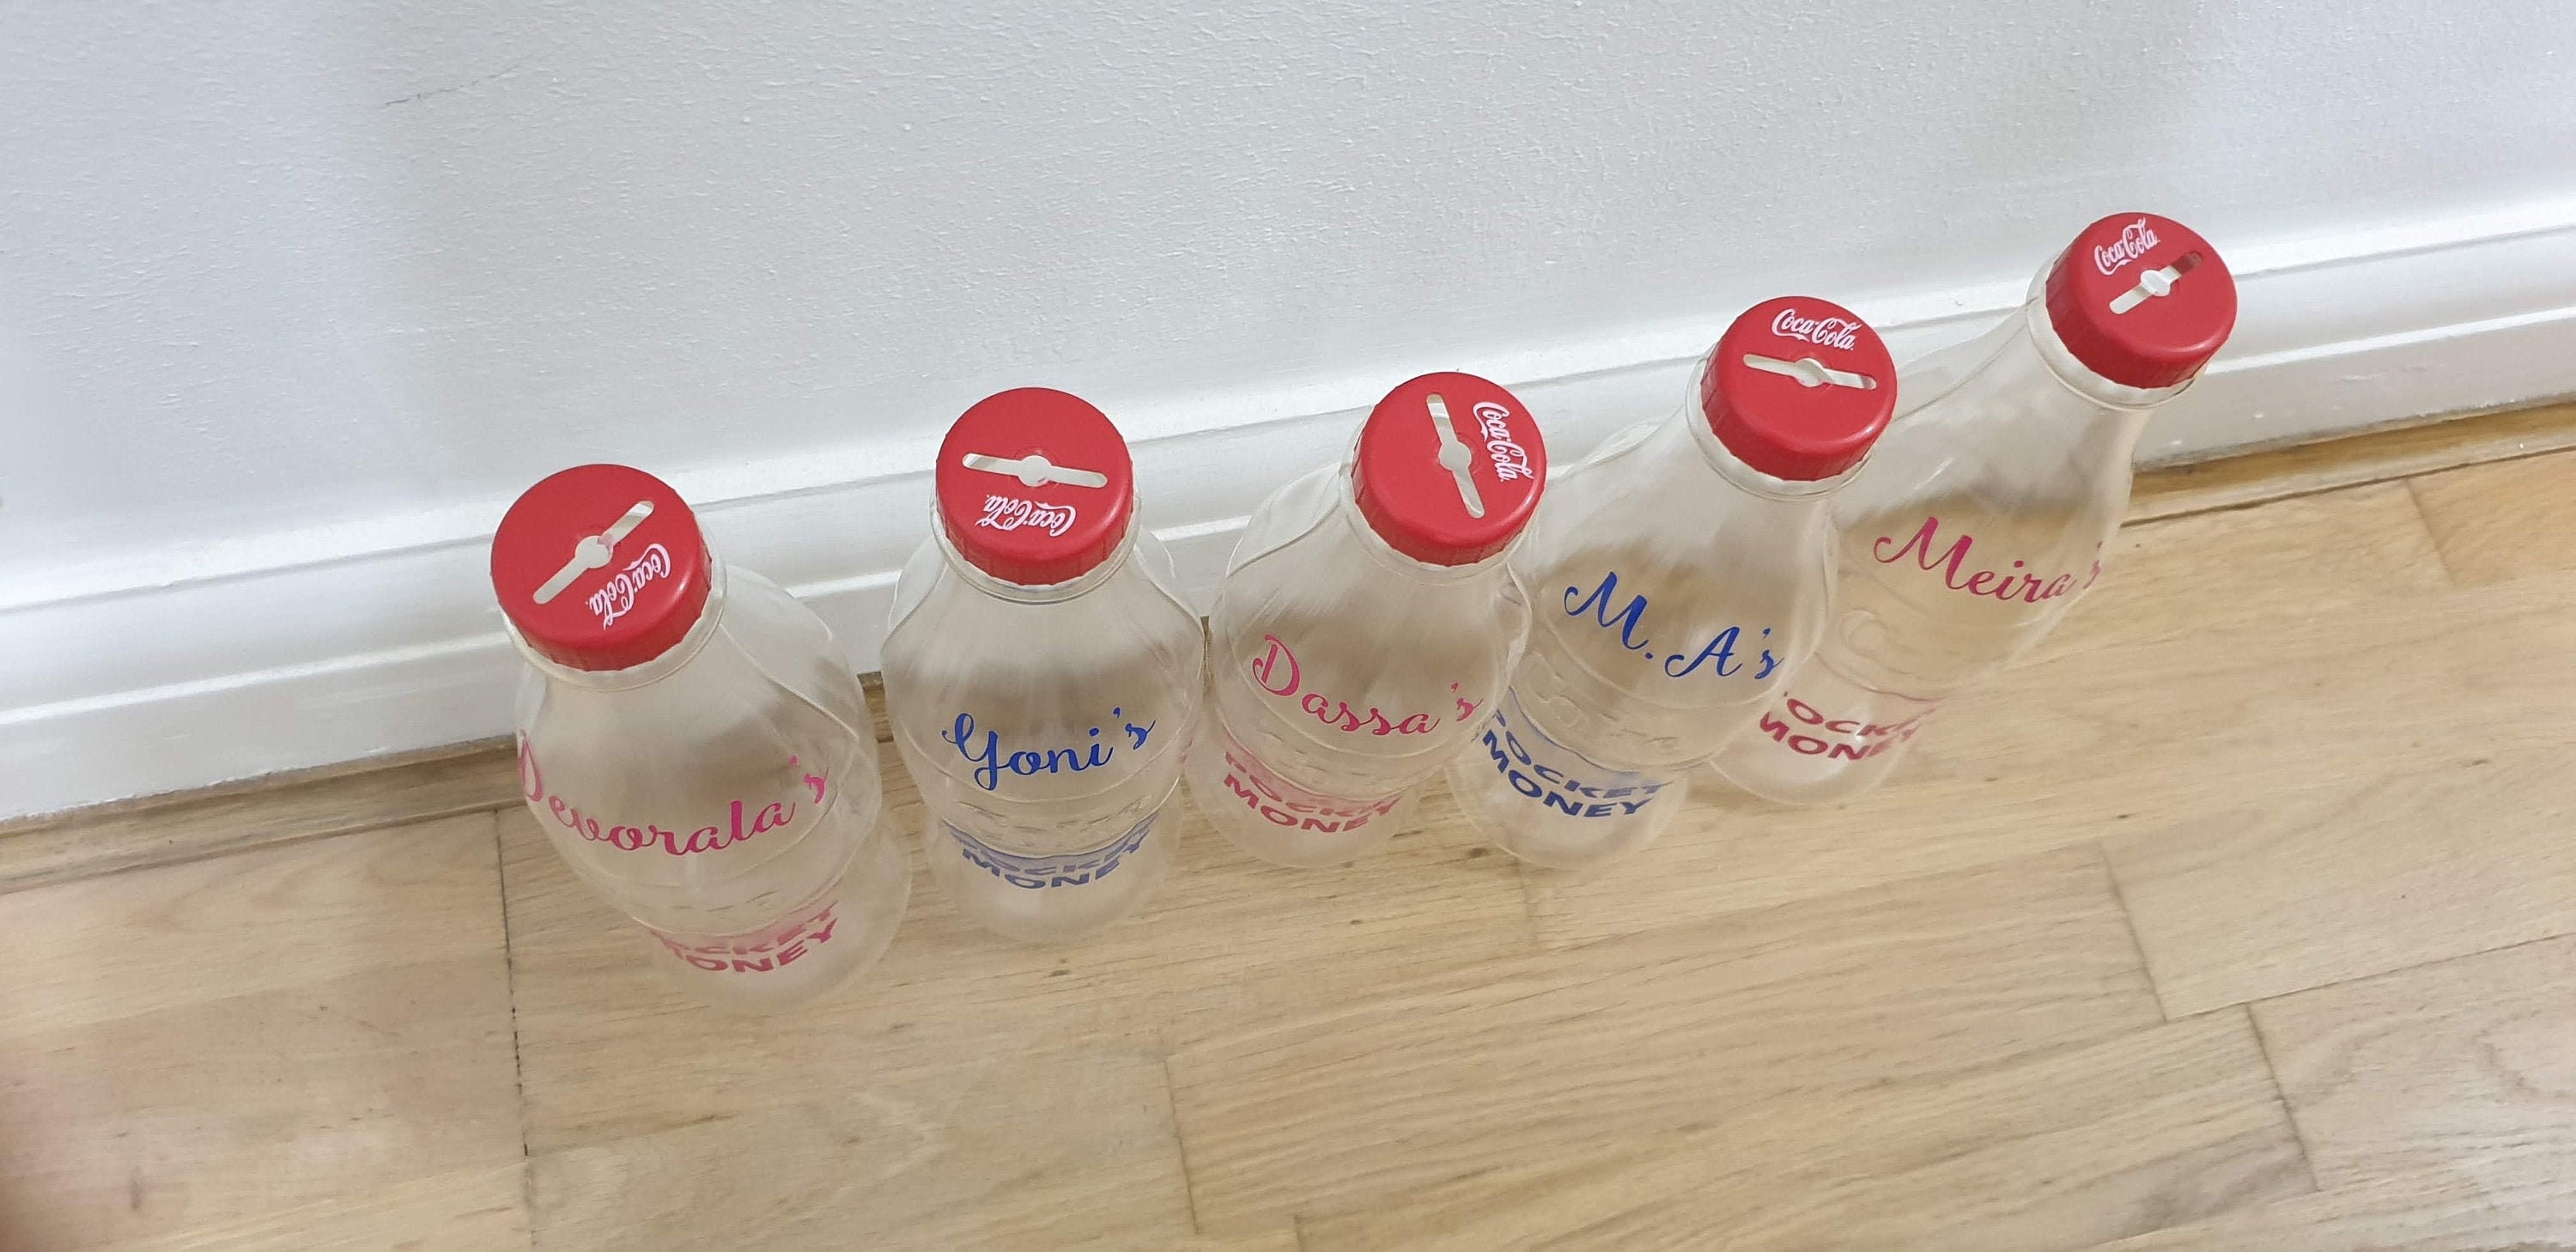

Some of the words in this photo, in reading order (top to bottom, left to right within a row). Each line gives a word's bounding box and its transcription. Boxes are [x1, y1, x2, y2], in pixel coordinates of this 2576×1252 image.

[1252, 635, 1484, 736] Dassa's
[942, 707, 1156, 791] Yoni's
[1482, 729, 1653, 817] MONEY
[1224, 774, 1402, 833] MONEY
